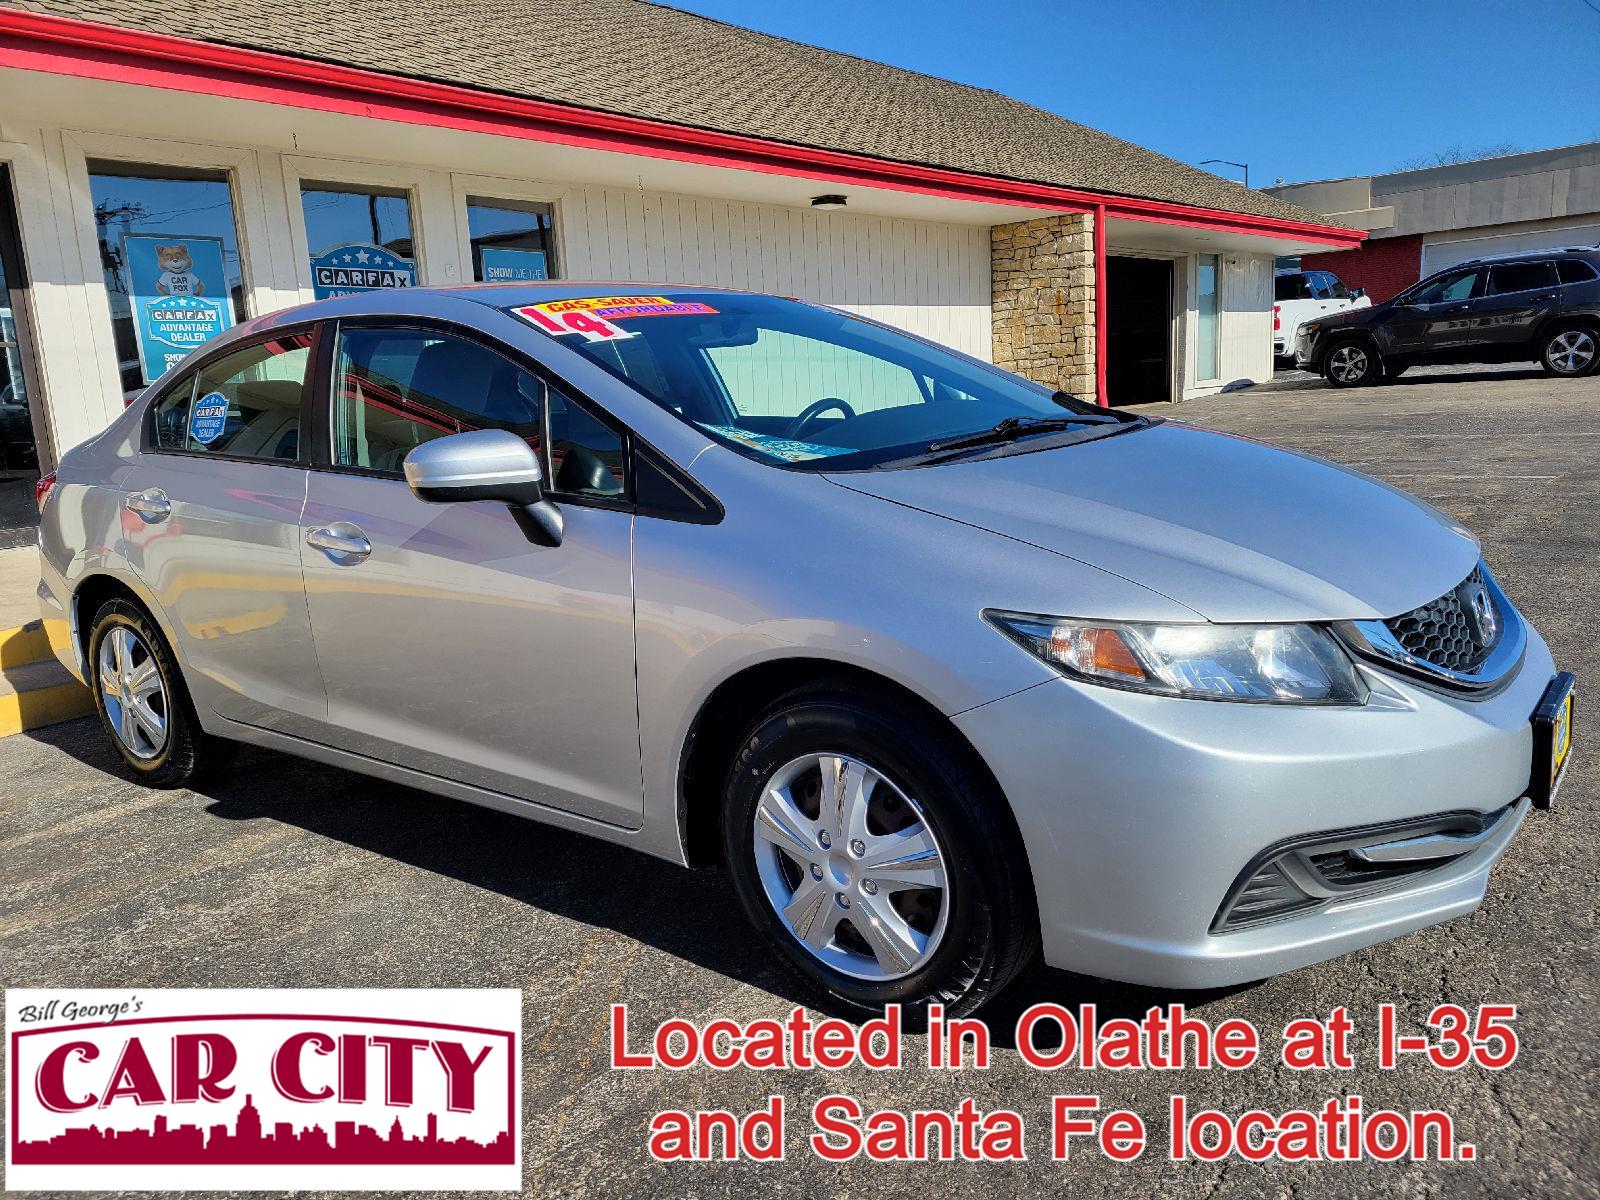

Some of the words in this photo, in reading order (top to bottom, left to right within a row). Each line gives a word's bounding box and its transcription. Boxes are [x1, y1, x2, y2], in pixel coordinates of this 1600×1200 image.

[488, 267, 513, 278] SHOW
[320, 270, 407, 287] CARFAX
[596, 303, 703, 316] AFFORDABLE
[153, 311, 216, 321] CARFAX
[160, 324, 214, 332] ADVANTAGE
[171, 333, 207, 342] DEALER
[196, 407, 225, 417] CARFAX
[196, 419, 221, 428] ADVANTAGE
